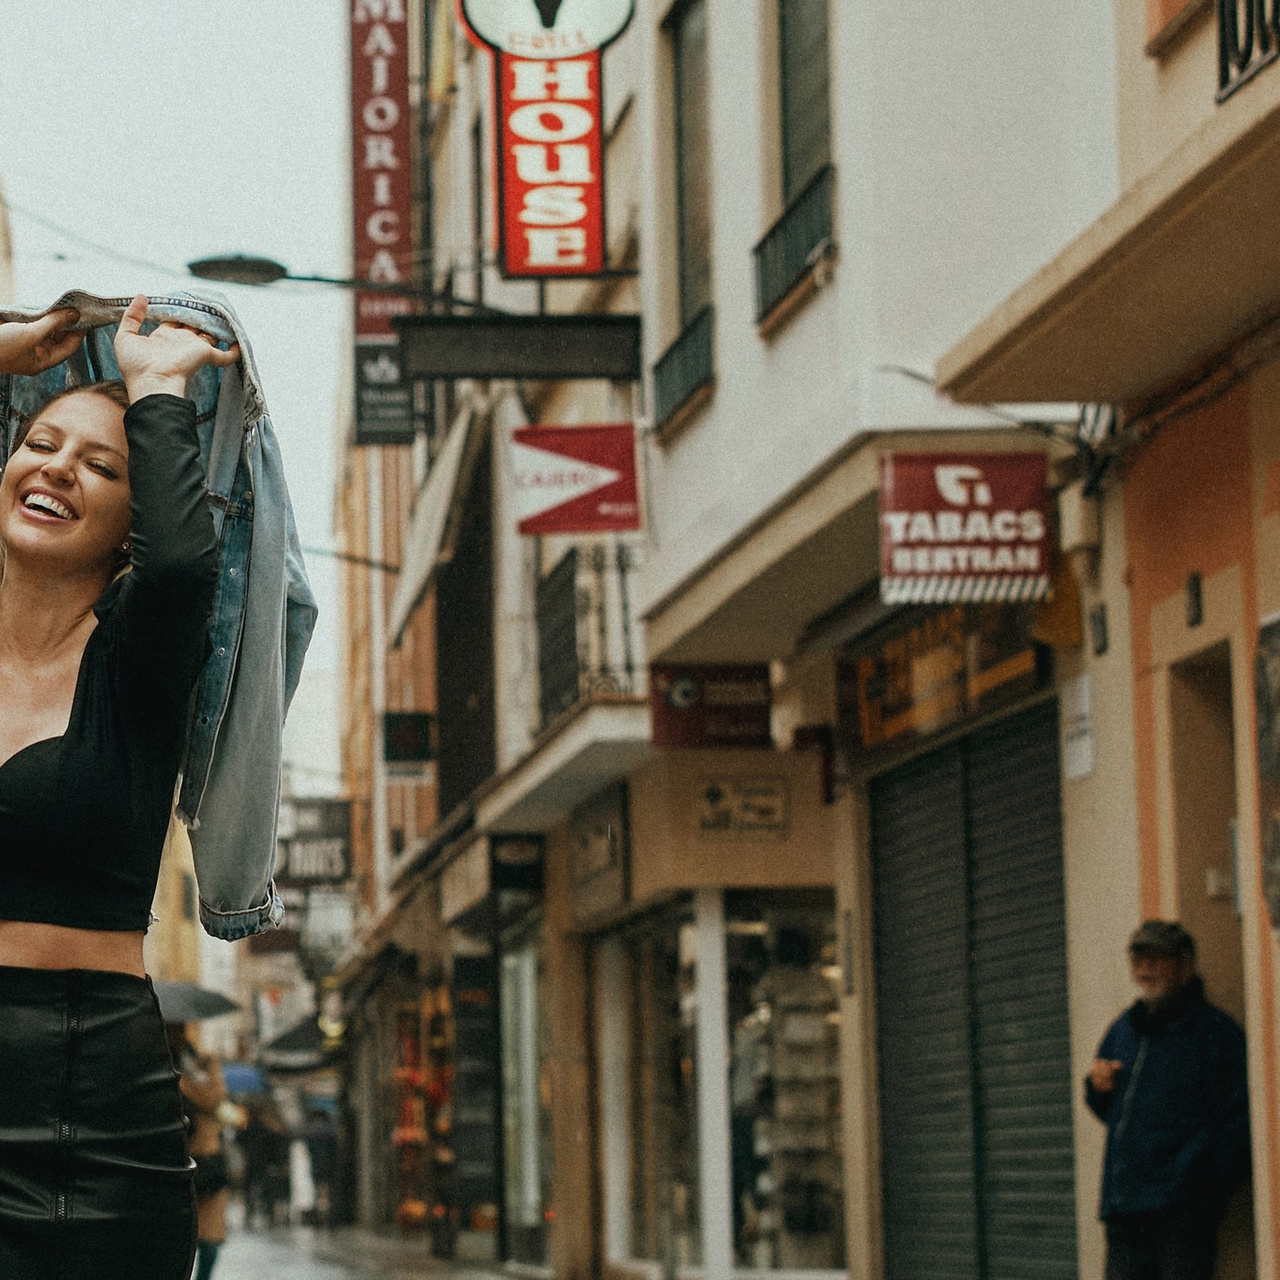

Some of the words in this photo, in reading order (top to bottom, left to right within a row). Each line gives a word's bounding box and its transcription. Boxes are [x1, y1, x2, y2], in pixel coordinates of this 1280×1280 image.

[508, 60, 593, 267] HOUSE
[882, 509, 1046, 542] TABACS
[891, 546, 1041, 572] BERTRAN
